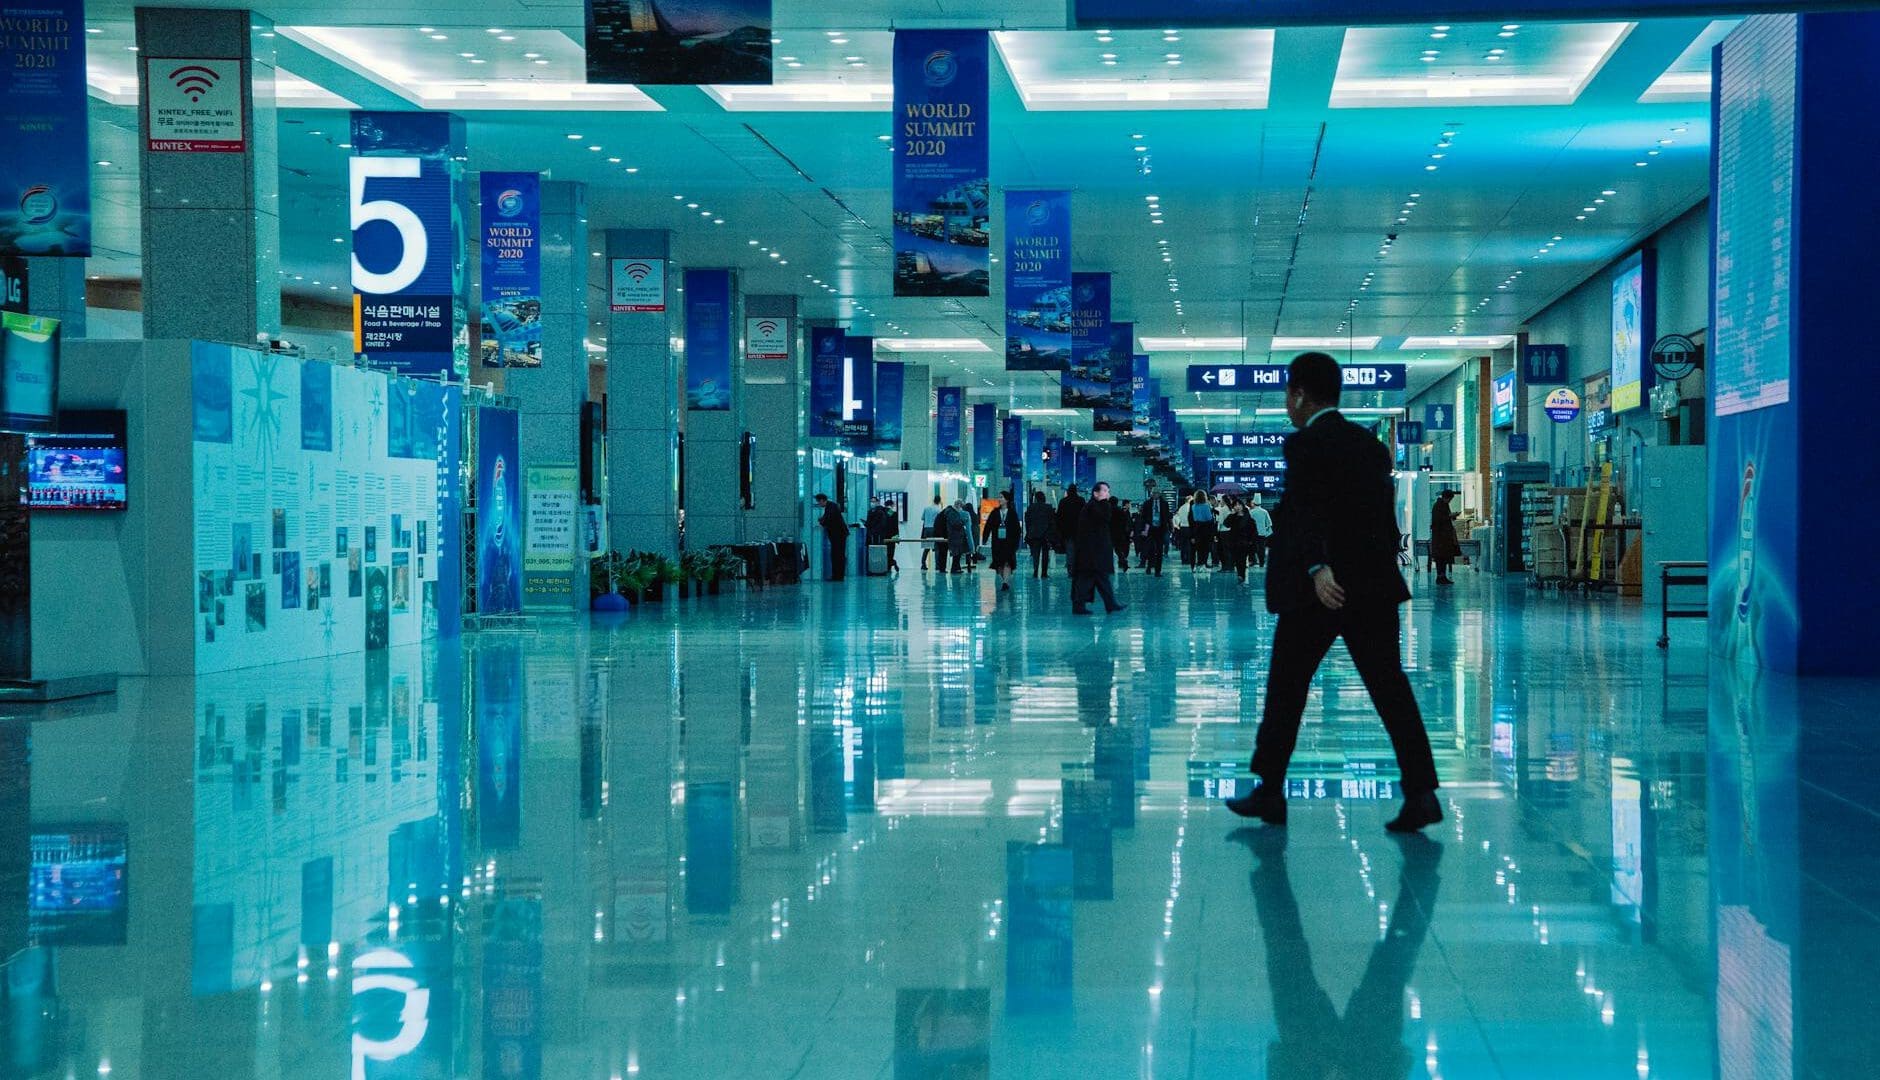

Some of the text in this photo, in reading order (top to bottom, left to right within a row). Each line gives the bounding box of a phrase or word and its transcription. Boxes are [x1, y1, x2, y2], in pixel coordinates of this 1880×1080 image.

[15, 53, 56, 68] 2020
[906, 104, 971, 118] WORLD
[158, 118, 174, 126] 무료
[904, 122, 976, 136] SUMMIT
[152, 142, 192, 150] KINTEX
[906, 140, 946, 156] 2020
[349, 156, 428, 294] 5
[489, 228, 532, 236] WORLD
[487, 238, 534, 248] SUMMIT
[1014, 236, 1058, 246] WORLD
[498, 249, 524, 258] 2020
[1014, 249, 1061, 259] SUMMIT
[1015, 262, 1042, 272] 2020
[8, 276, 20, 302] LG
[364, 305, 440, 318] 식음판매시설
[1072, 319, 1104, 328] UMMIT
[365, 332, 402, 341] 제2전시장
[1072, 329, 1088, 337] 020
[1662, 352, 1688, 363] TLJ
[1254, 370, 1280, 384] Hall
[1242, 435, 1258, 444] Hall
